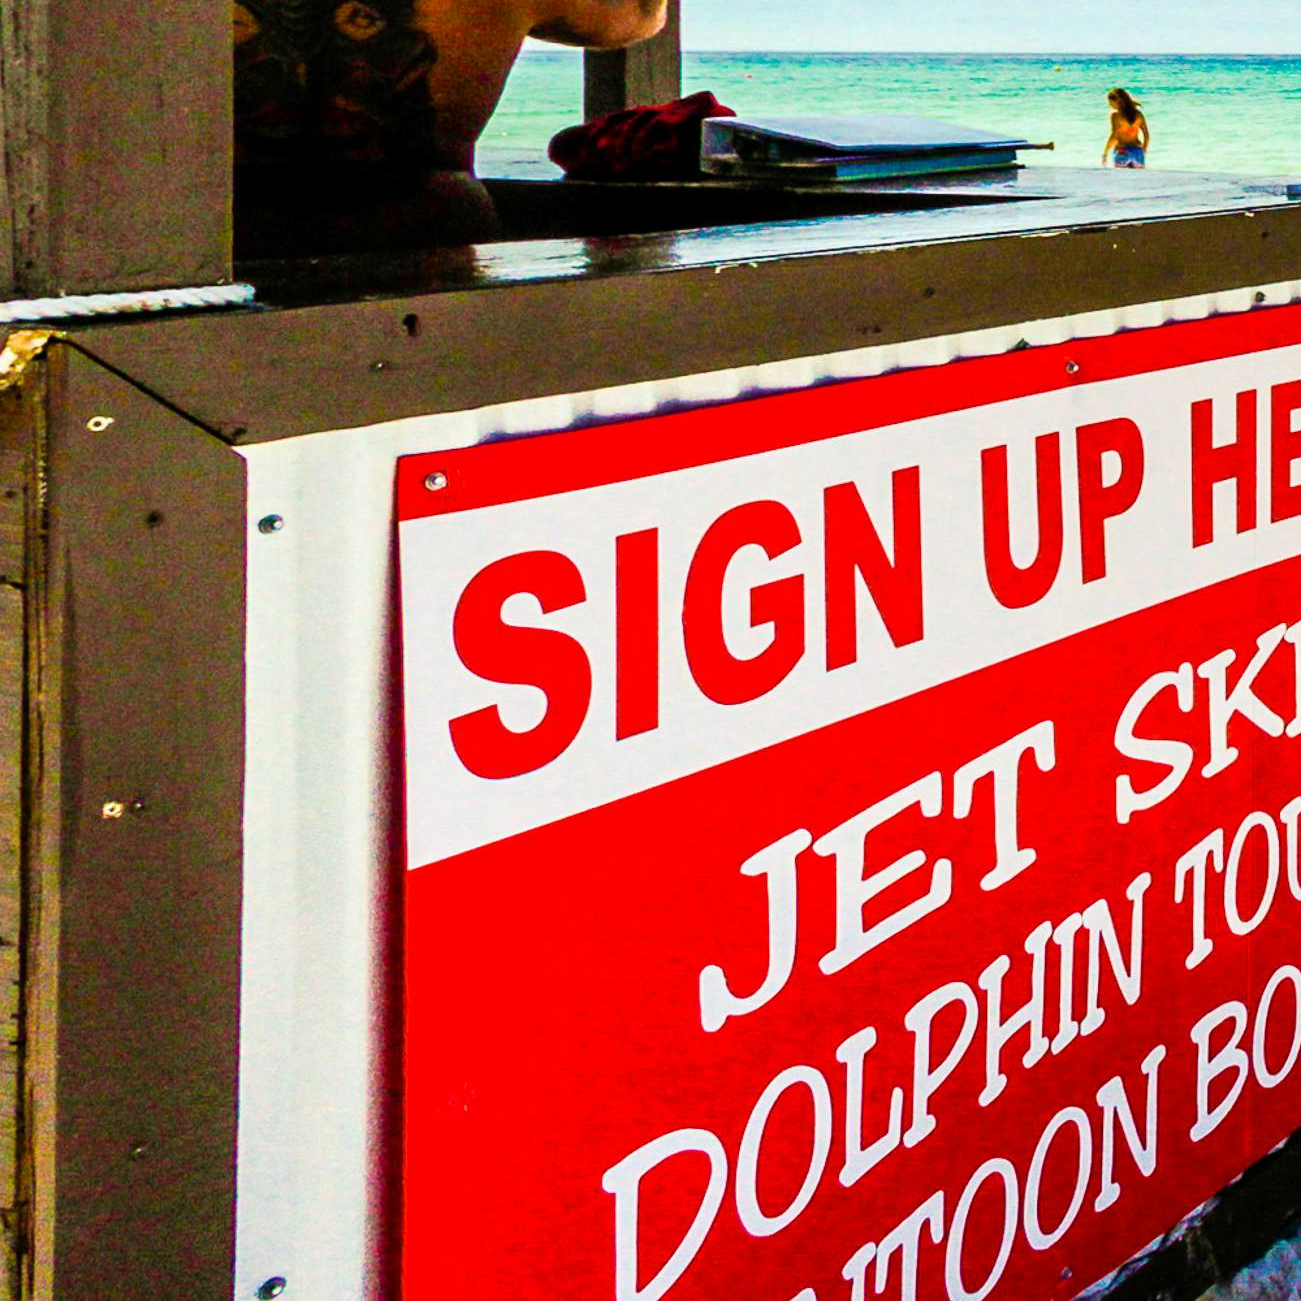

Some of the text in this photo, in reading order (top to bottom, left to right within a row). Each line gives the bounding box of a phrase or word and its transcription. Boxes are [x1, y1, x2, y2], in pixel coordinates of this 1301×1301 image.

[448, 465, 925, 780] SIGN
[980, 417, 1145, 610] UP
[699, 720, 1056, 1033] JET
[601, 872, 1152, 1301] DOLPHIN
